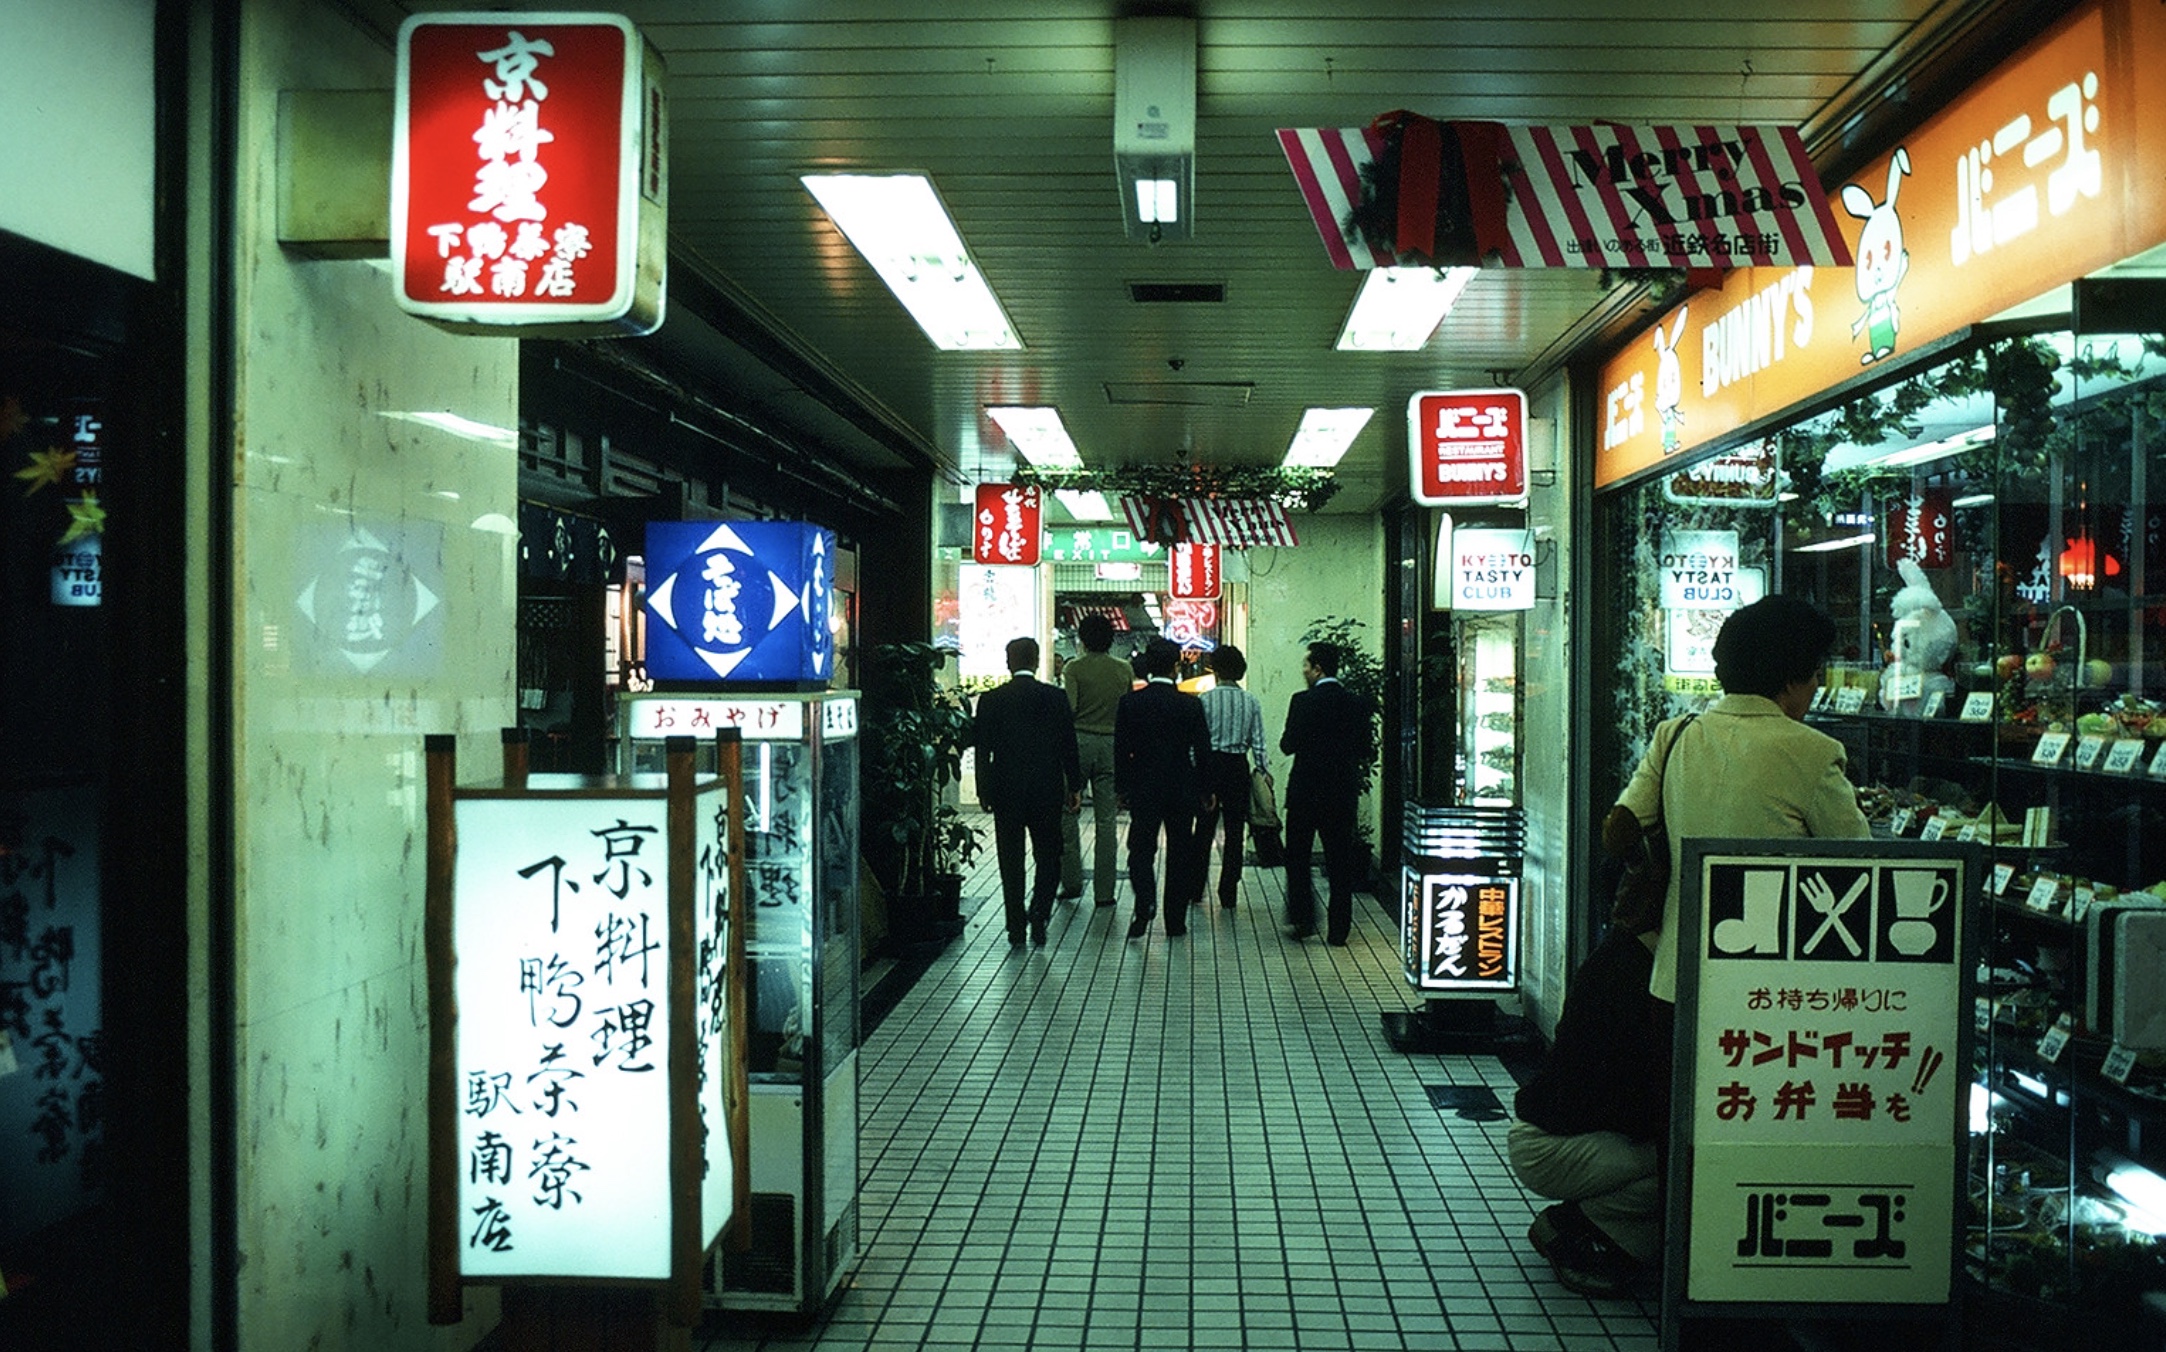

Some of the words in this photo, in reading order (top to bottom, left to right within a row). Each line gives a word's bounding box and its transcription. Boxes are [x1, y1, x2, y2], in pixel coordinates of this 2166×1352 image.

[472, 31, 555, 222] 京料理
[1564, 139, 1751, 190] Merry
[1951, 71, 2101, 267] バニーズ
[1620, 180, 1806, 230] Xmas
[427, 222, 592, 262] 下鴨茶寮
[1662, 233, 1779, 256] 近鉄名店街
[440, 255, 576, 297] 駅南店
[1702, 265, 1814, 398] BUNNY'S
[1436, 407, 1508, 438] バニーズ
[1438, 462, 1508, 482] BUNNY'S
[1053, 549, 1111, 560] EXIT
[1461, 553, 1531, 568] KYOTO
[1463, 570, 1523, 583] TASTY
[1463, 586, 1512, 599] CLUB
[654, 703, 786, 729] おみやげ
[590, 818, 661, 1072] 京料理
[1477, 887, 1505, 977] 中華レストラン
[1747, 987, 1907, 1012] お持ち帰りに
[517, 855, 591, 1211] 下鴨茶寮
[1718, 1029, 1911, 1069] サンドイッチ
[1716, 1080, 1911, 1122] お弁当を
[464, 1070, 523, 1253] 駅南店
[1737, 1193, 1906, 1258] バニーズ
